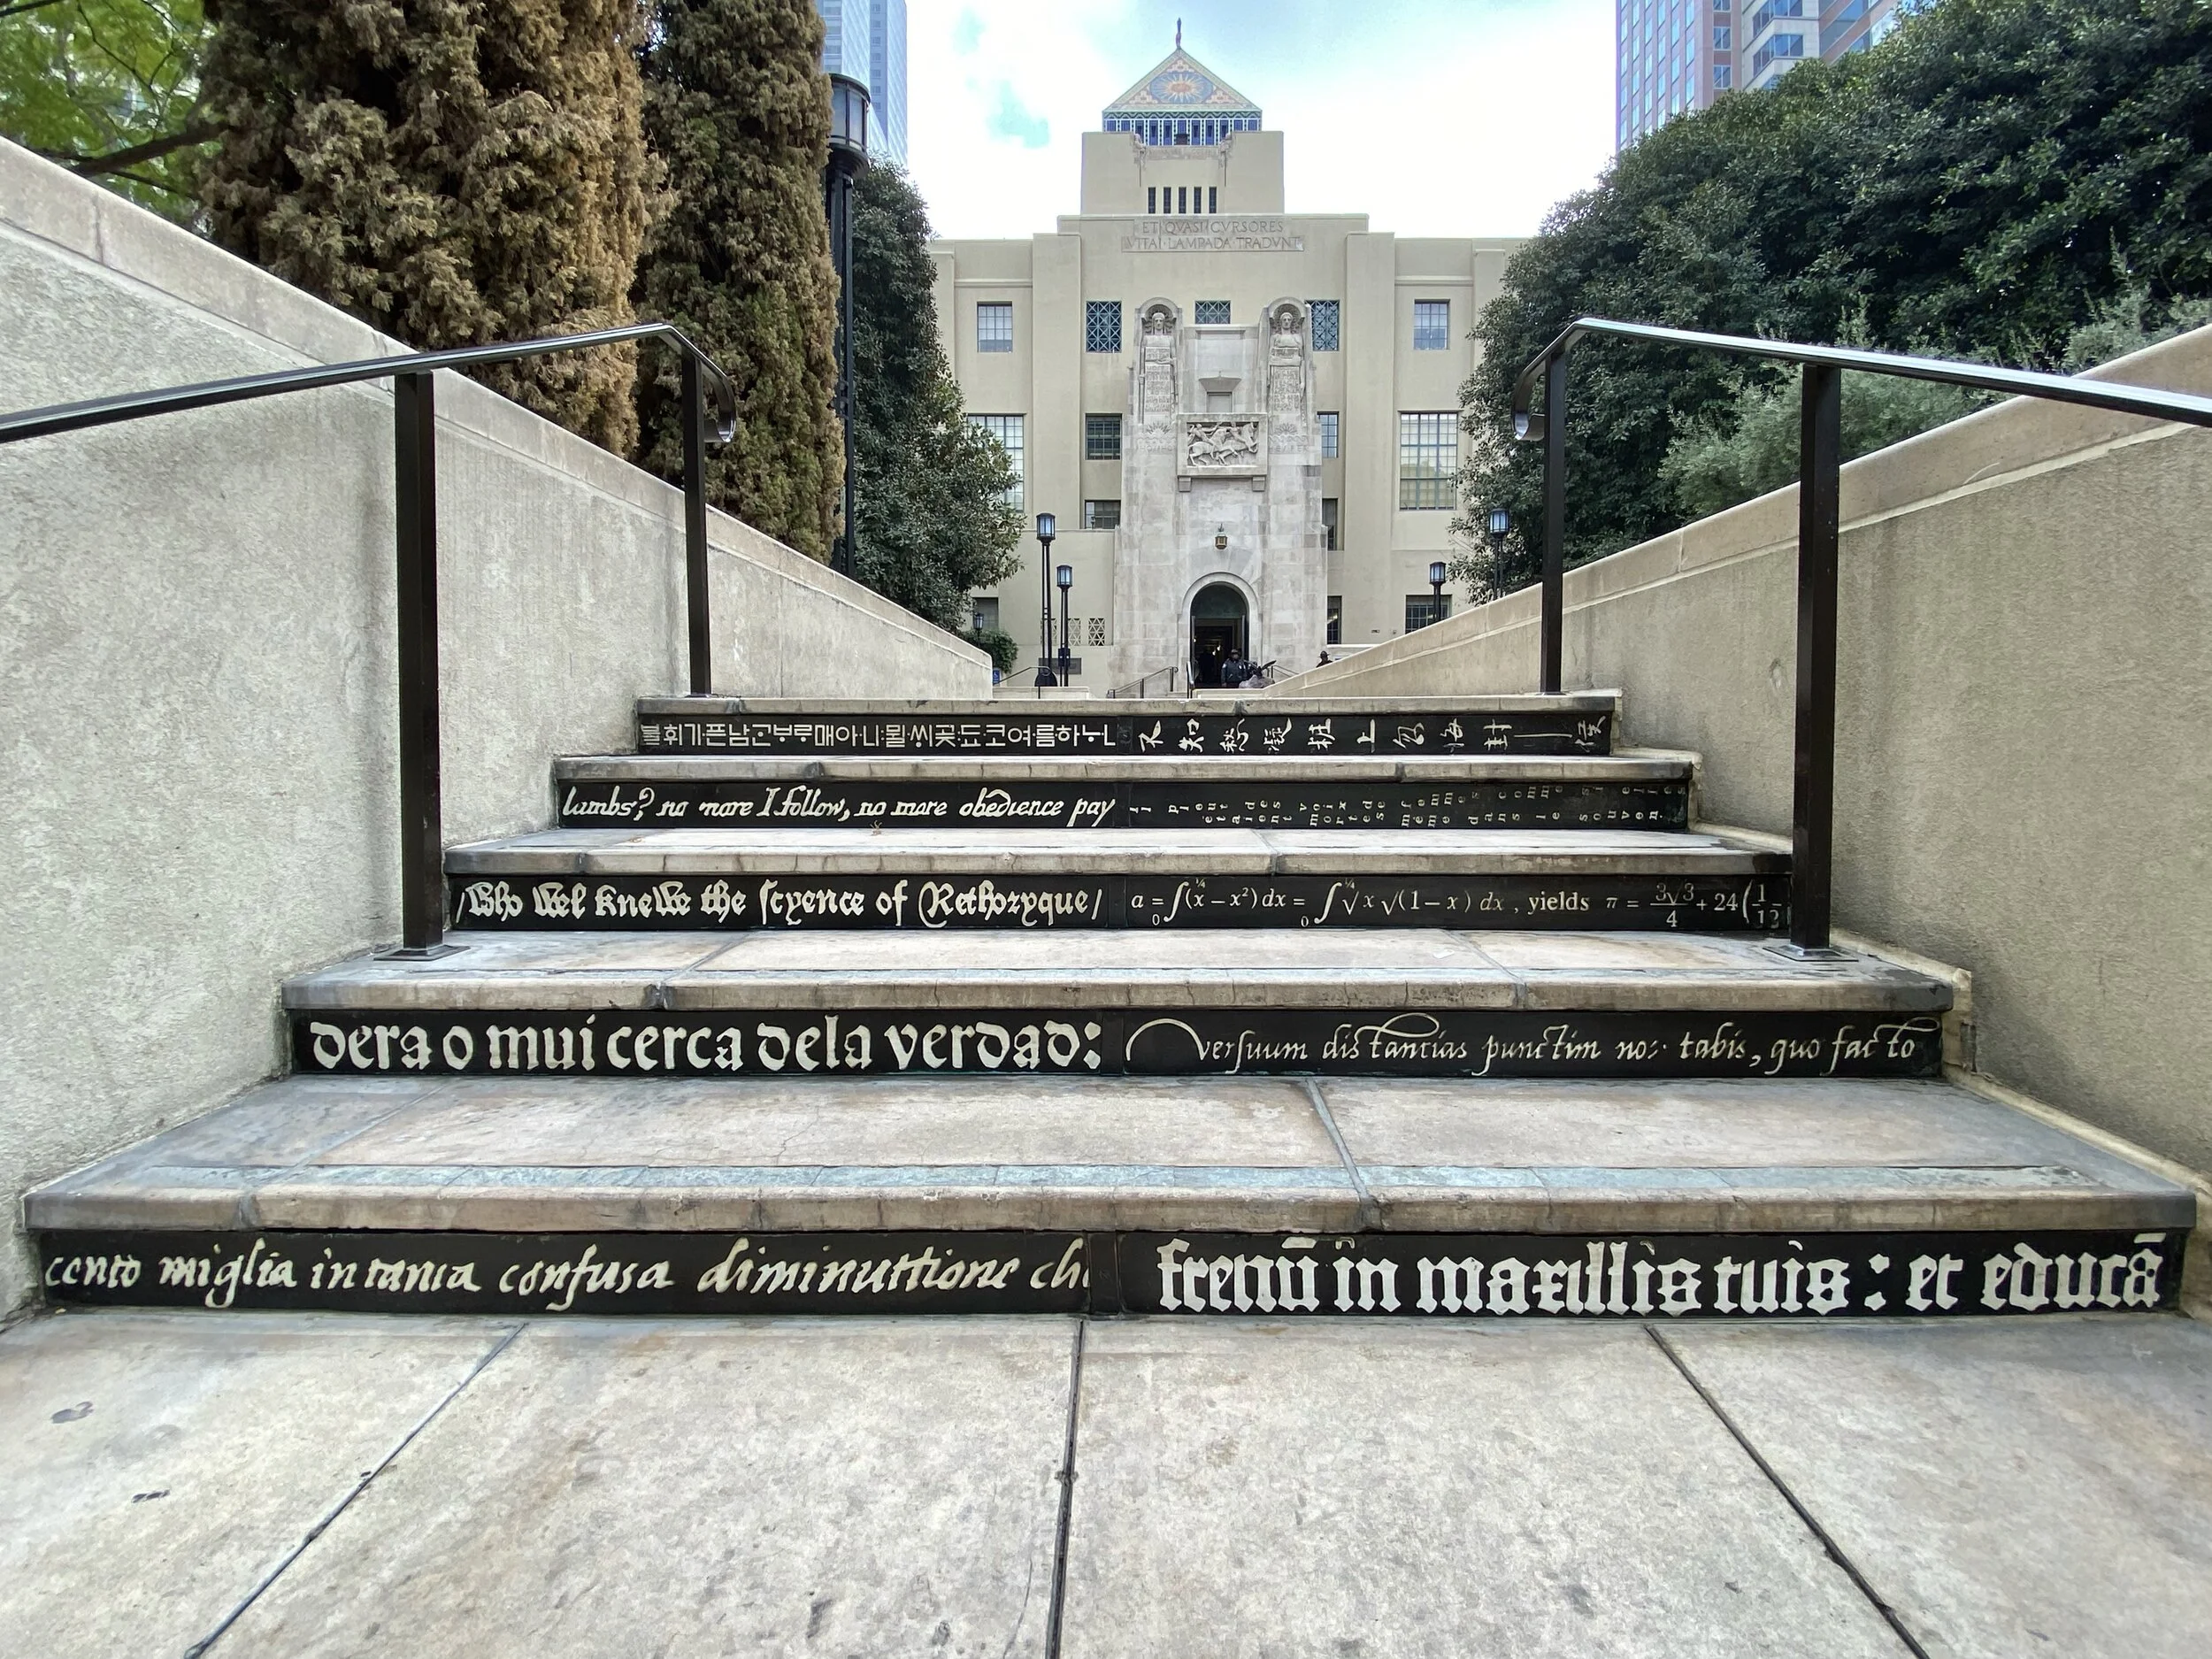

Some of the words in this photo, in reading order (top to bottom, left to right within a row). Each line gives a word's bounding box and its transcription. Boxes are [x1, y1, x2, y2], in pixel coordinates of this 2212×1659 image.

[1141, 221, 1158, 234] ET
[1164, 221, 1204, 235] QVASI
[1210, 220, 1284, 234] CVRSORES
[1168, 237, 1231, 250] LAMPADA
[1236, 236, 1302, 250] TRADVNT
[698, 801, 754, 818] more
[853, 801, 887, 817] no
[889, 801, 948, 817] more
[958, 787, 1064, 818] obedience
[1065, 797, 1116, 827] pay
[875, 879, 909, 926] of
[1527, 888, 1591, 915] yields
[442, 1025, 474, 1071] o
[486, 1008, 595, 1071] mui
[606, 1025, 744, 1071] cerca
[757, 1015, 872, 1071] dela
[151, 1237, 298, 1310] miglia
[498, 1243, 674, 1311] confusa
[1029, 1237, 1089, 1289] ch
[1905, 1253, 1964, 1312] et
